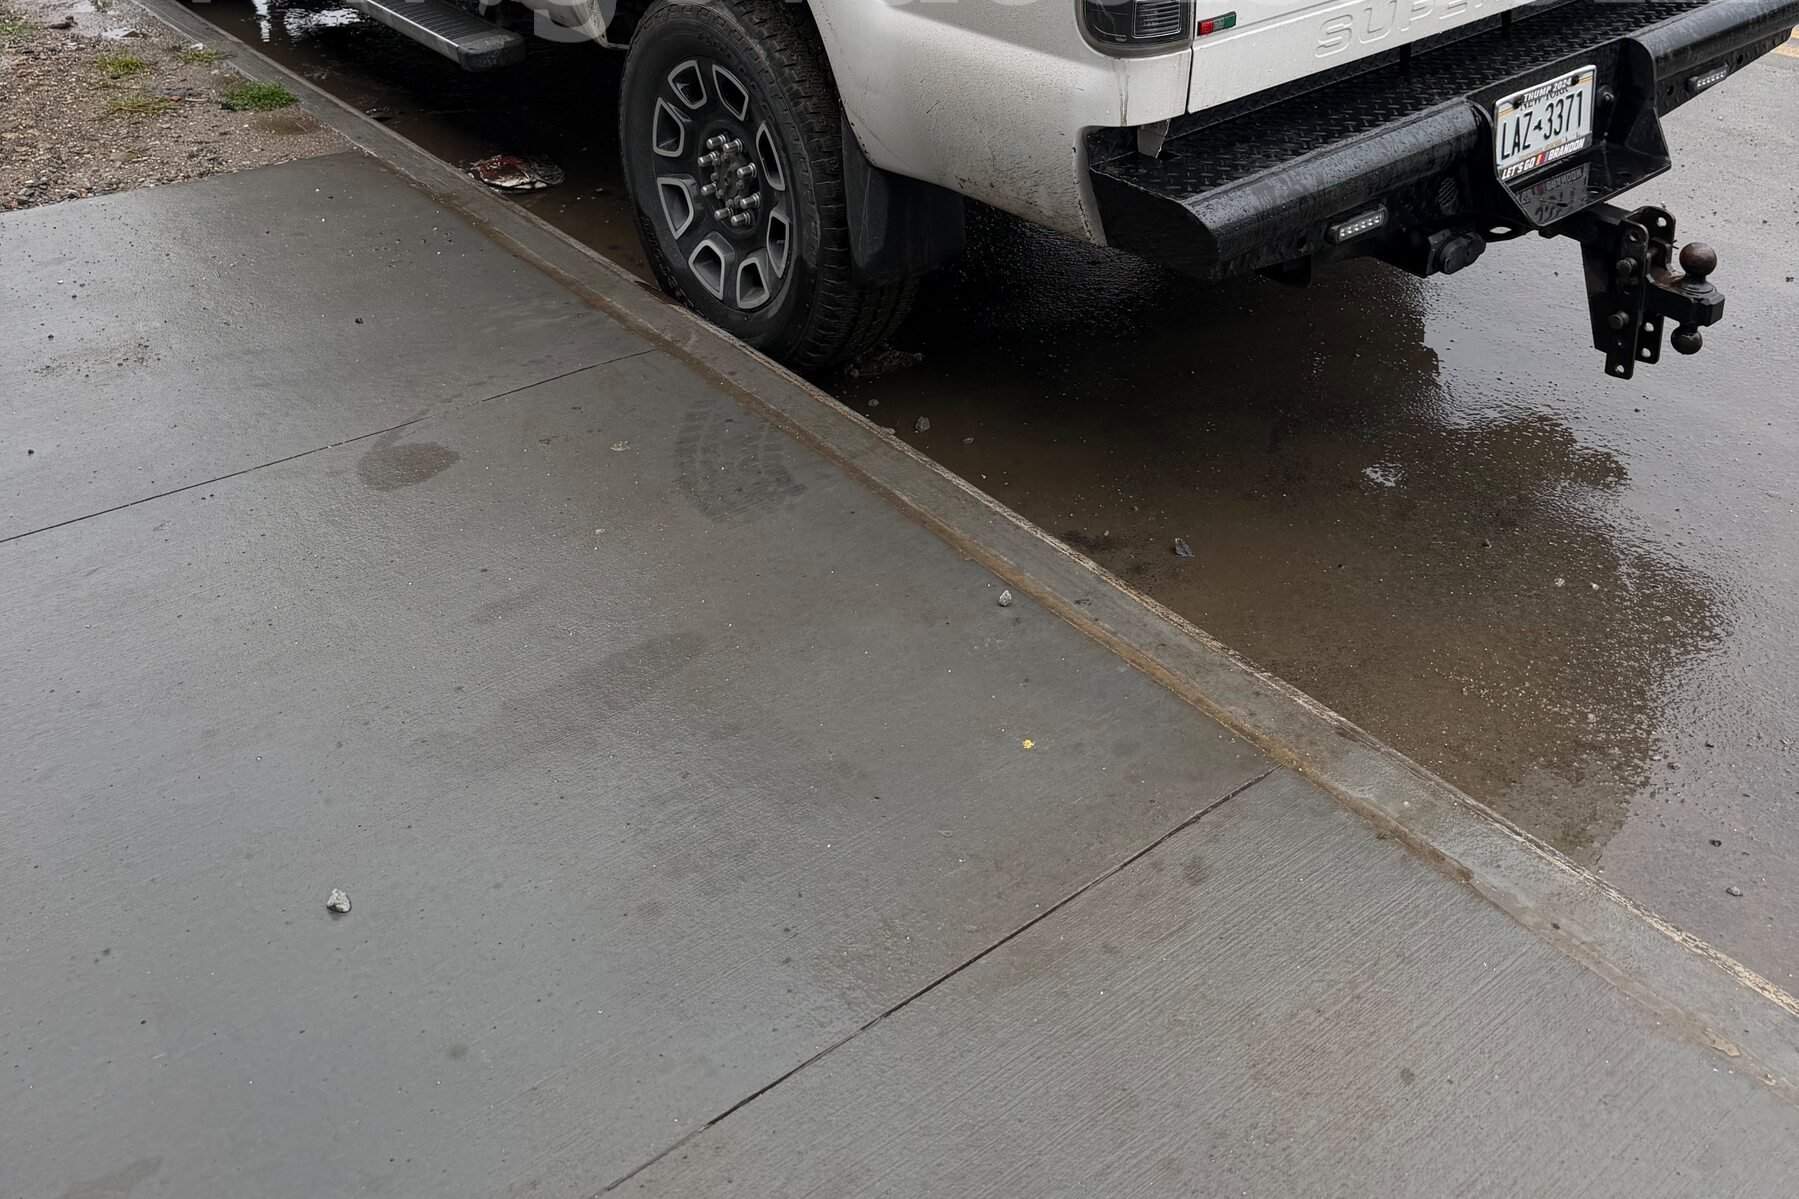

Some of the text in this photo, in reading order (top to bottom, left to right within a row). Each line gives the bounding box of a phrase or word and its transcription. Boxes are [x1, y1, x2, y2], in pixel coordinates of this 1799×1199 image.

[1523, 77, 1572, 102] TRUMP 2024
[1501, 111, 1533, 160] LAZ
[1543, 90, 1584, 141] 3371
[1501, 161, 1525, 180] LET'S
[1524, 156, 1537, 171] GO
[1547, 138, 1586, 161] BRANDON
